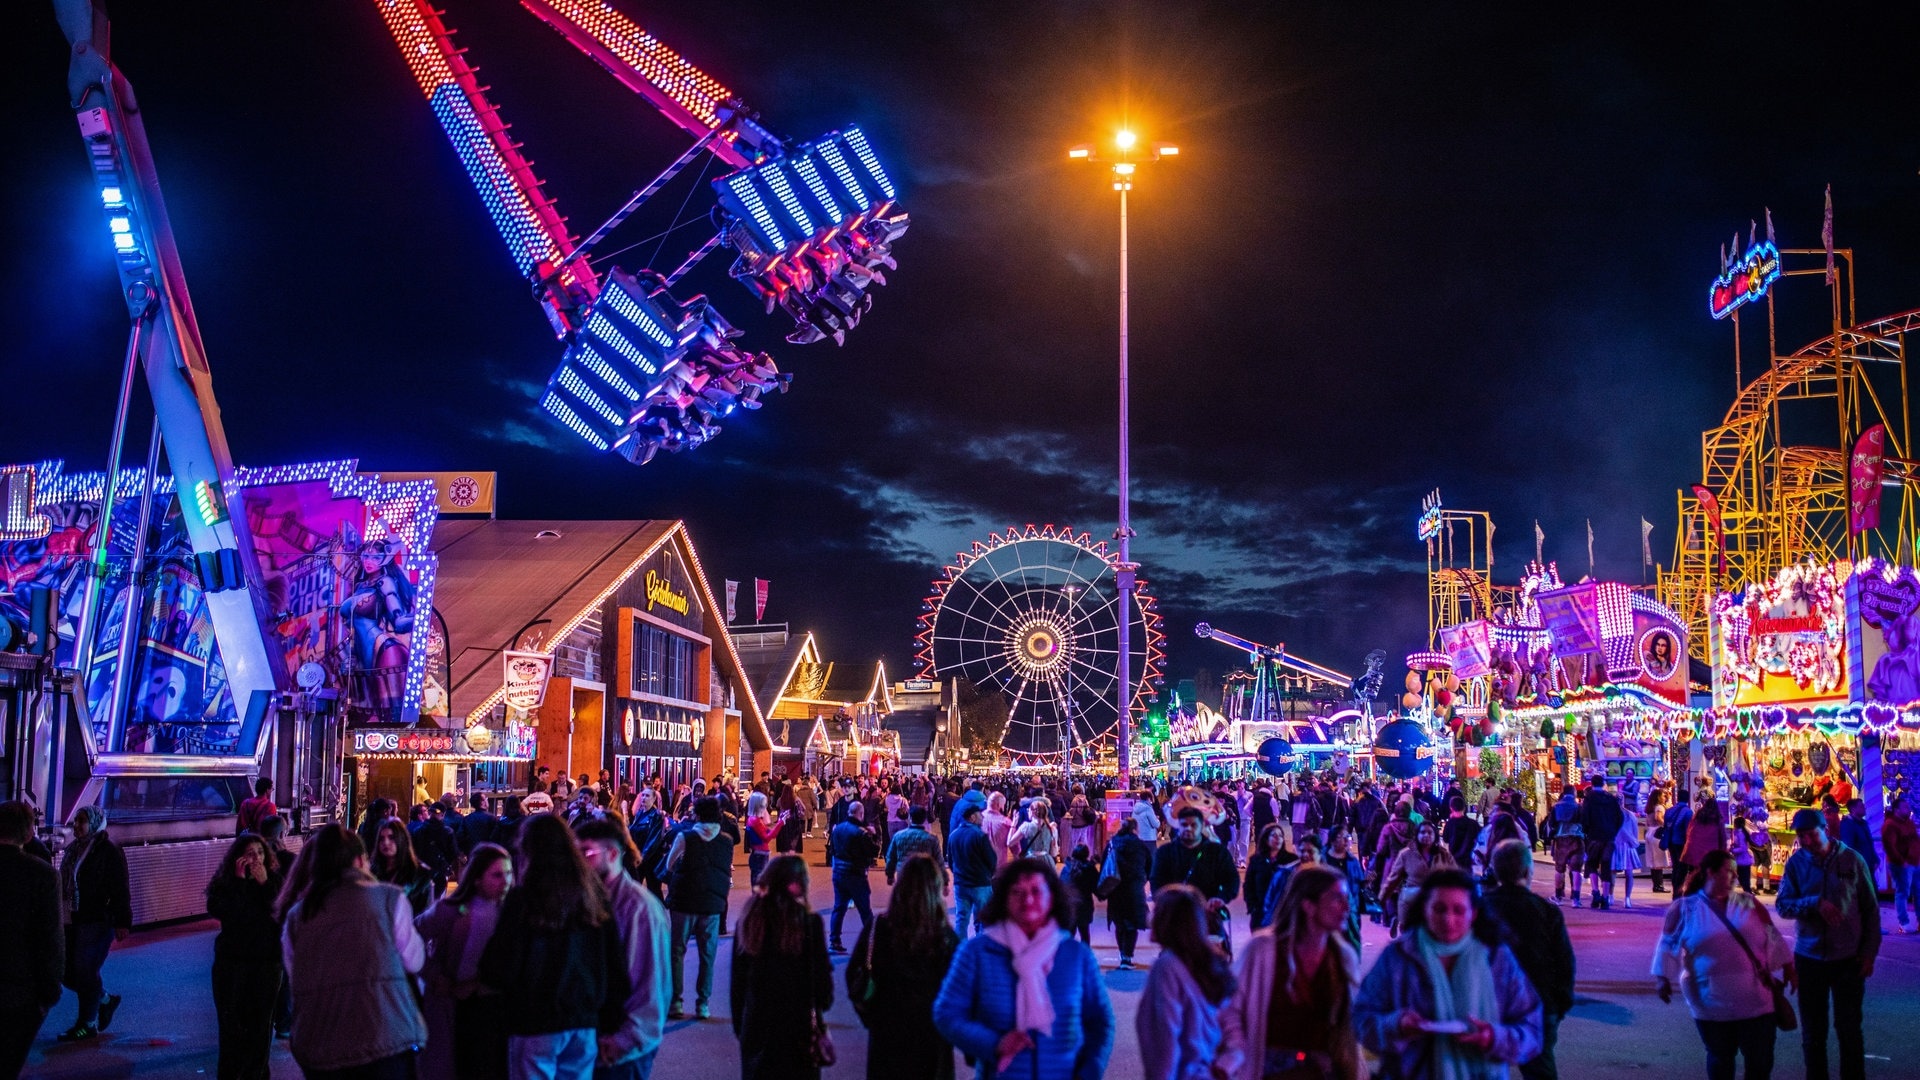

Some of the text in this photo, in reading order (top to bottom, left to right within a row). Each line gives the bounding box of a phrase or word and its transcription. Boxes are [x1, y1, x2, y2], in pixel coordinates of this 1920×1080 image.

[289, 565, 331, 600] OUTH
[509, 690, 540, 698] nutella
[640, 718, 692, 742] WULLE BIERE
[384, 733, 453, 753] Crêpes
